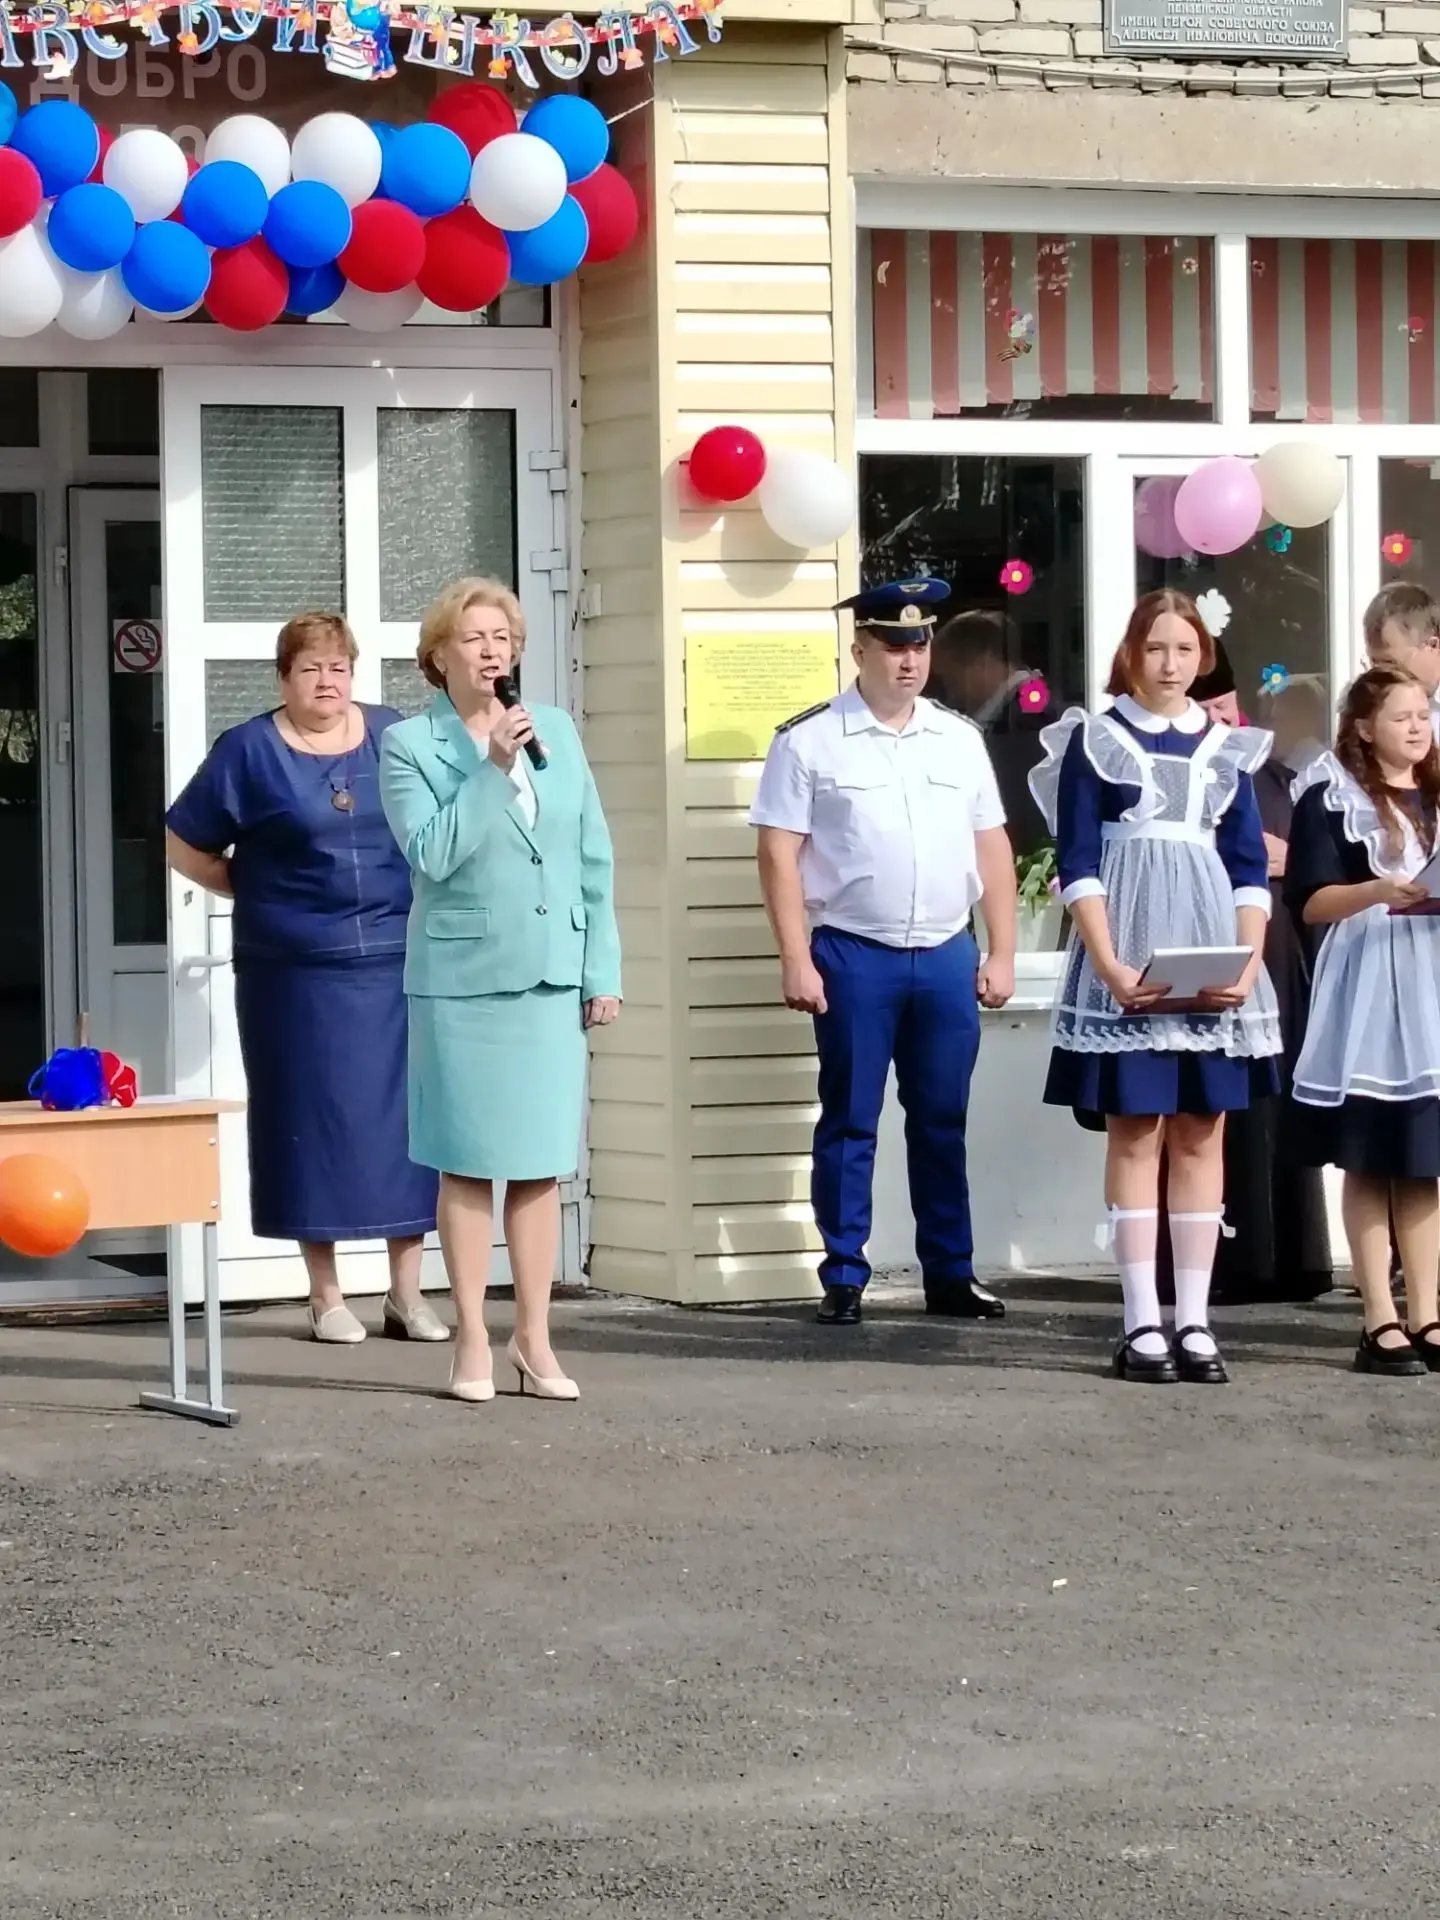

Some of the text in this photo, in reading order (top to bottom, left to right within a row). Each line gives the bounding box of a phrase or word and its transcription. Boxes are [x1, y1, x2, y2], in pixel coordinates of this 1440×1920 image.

[1244, 5, 1293, 17] ОБЛАСТИ
[1120, 15, 1335, 33] ИМЕНИ ГЕРОЯ СОВЕТСКОГО СОЮЗА
[1122, 28, 1330, 46] АЛЕКСЕЯ ИВАНОВИЧА БОРОДИНА
[29, 40, 267, 105] ДОБРО
